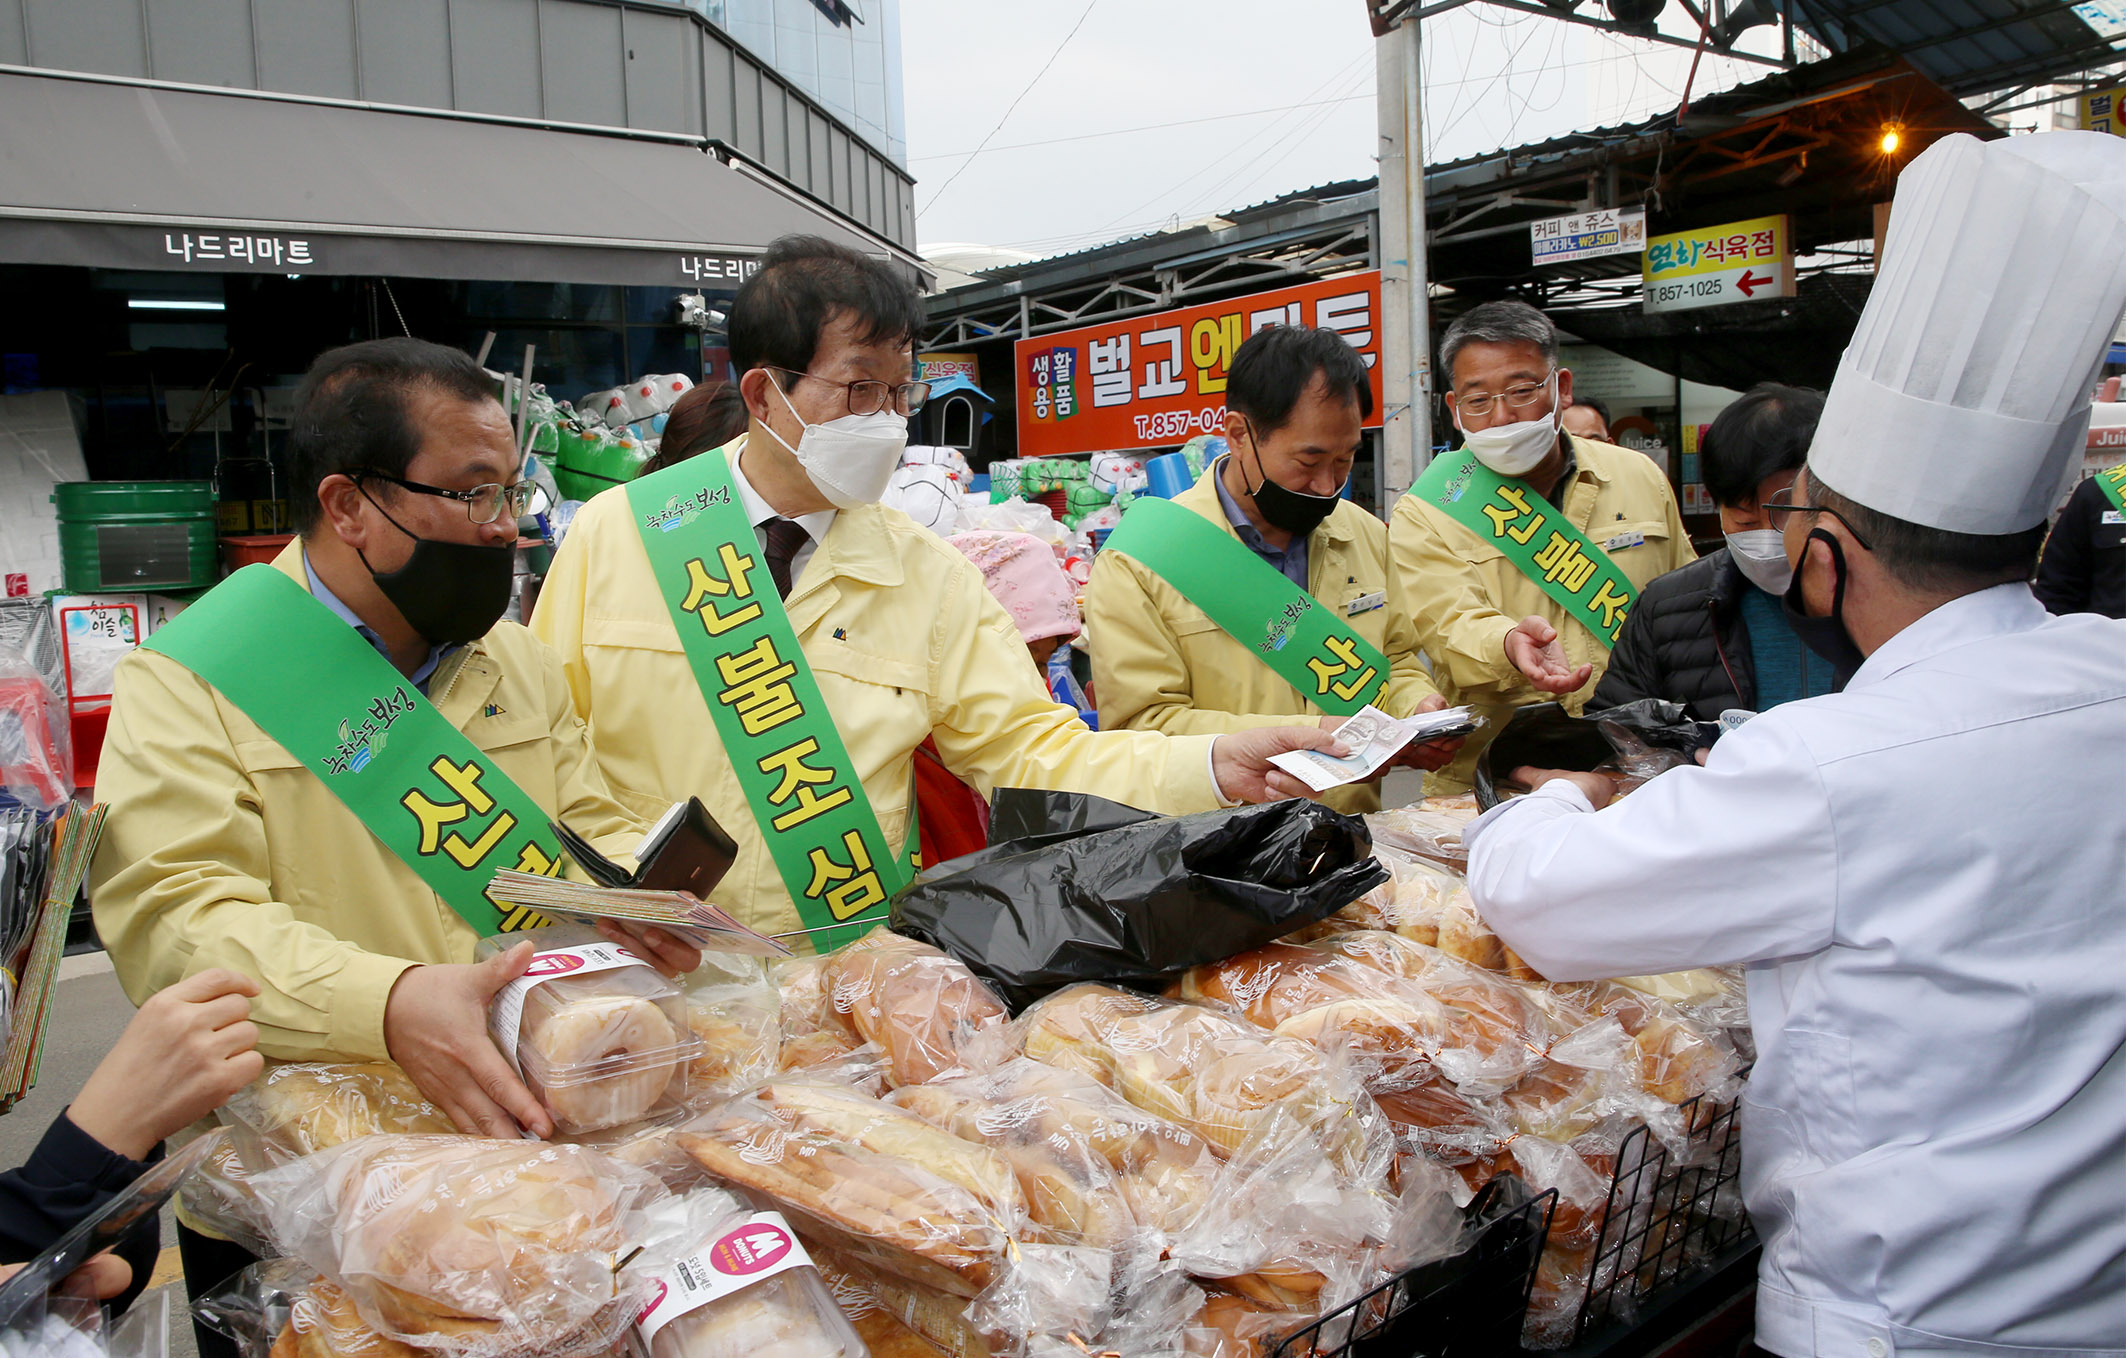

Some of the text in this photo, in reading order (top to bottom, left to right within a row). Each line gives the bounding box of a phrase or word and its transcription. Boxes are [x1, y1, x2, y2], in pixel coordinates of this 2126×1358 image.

[1534, 212, 1615, 238] 커피 앤 쥬스
[165, 234, 314, 265] 나드리마트
[1647, 279, 1722, 305] T.857-1025
[695, 483, 732, 513] 보성
[1283, 595, 1313, 623] 보성
[92, 617, 118, 638] 이슬
[367, 685, 416, 731] 보성
[680, 540, 887, 923] 산불조심
[732, 1237, 756, 1266] DONUTS
